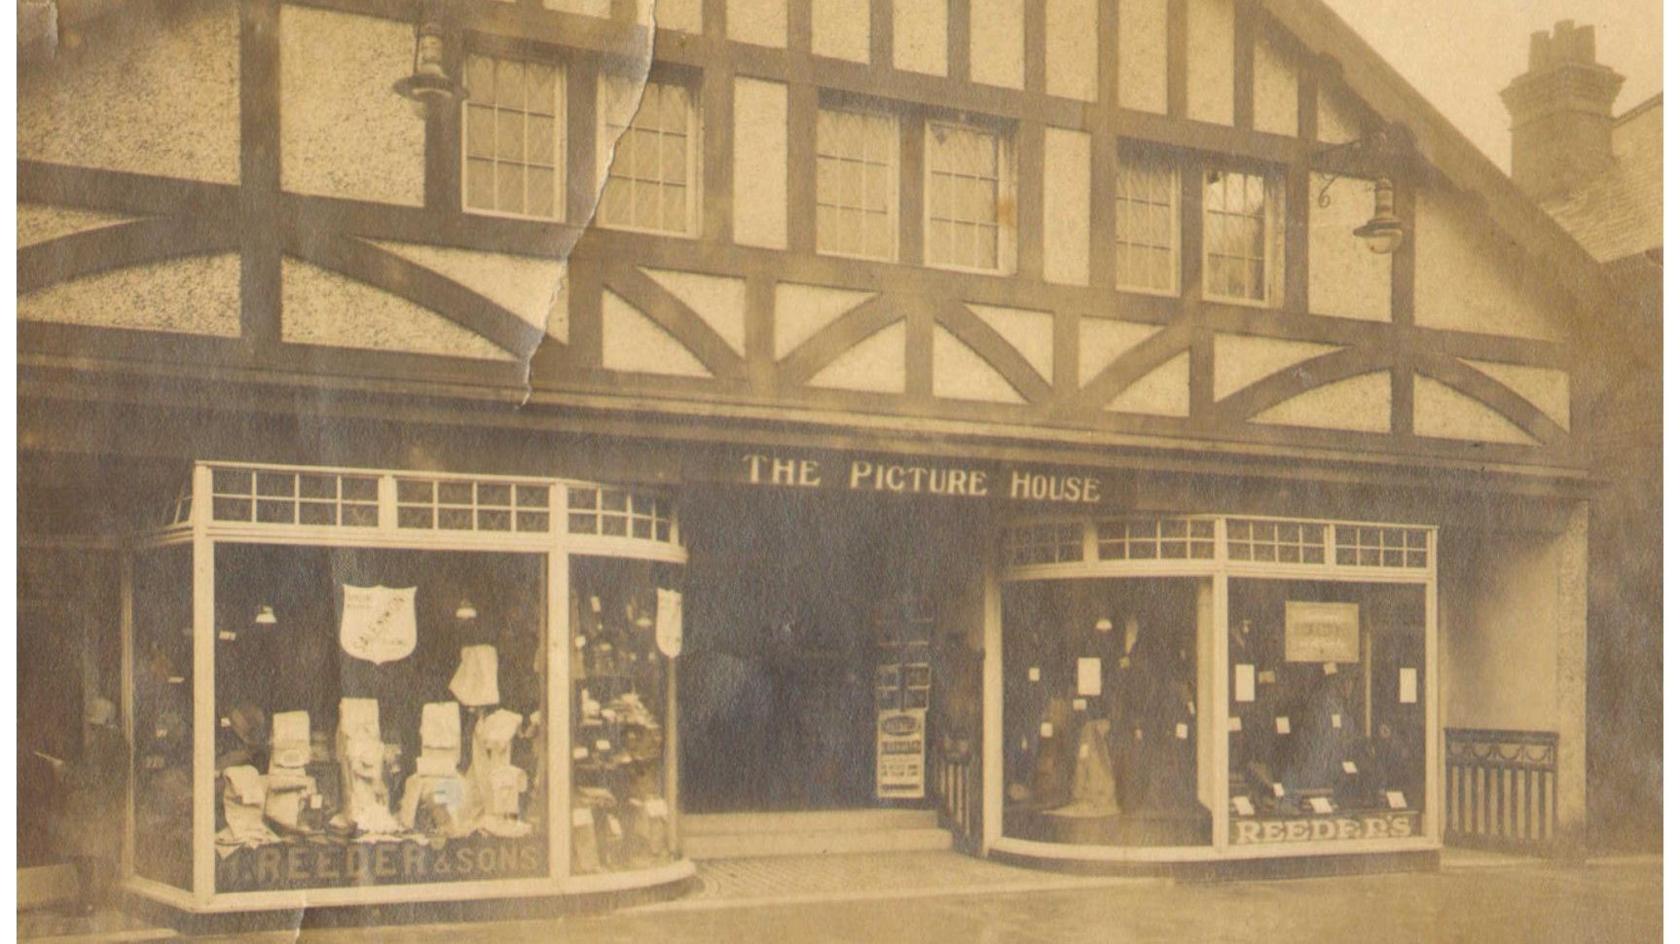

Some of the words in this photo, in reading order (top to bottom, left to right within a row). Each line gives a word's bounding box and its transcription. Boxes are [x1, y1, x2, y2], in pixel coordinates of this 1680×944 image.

[743, 454, 821, 487] THE
[850, 460, 988, 497] PICTURE
[1010, 470, 1101, 503] HOUSE
[433, 853, 451, 874] &
[456, 845, 539, 874] SONS
